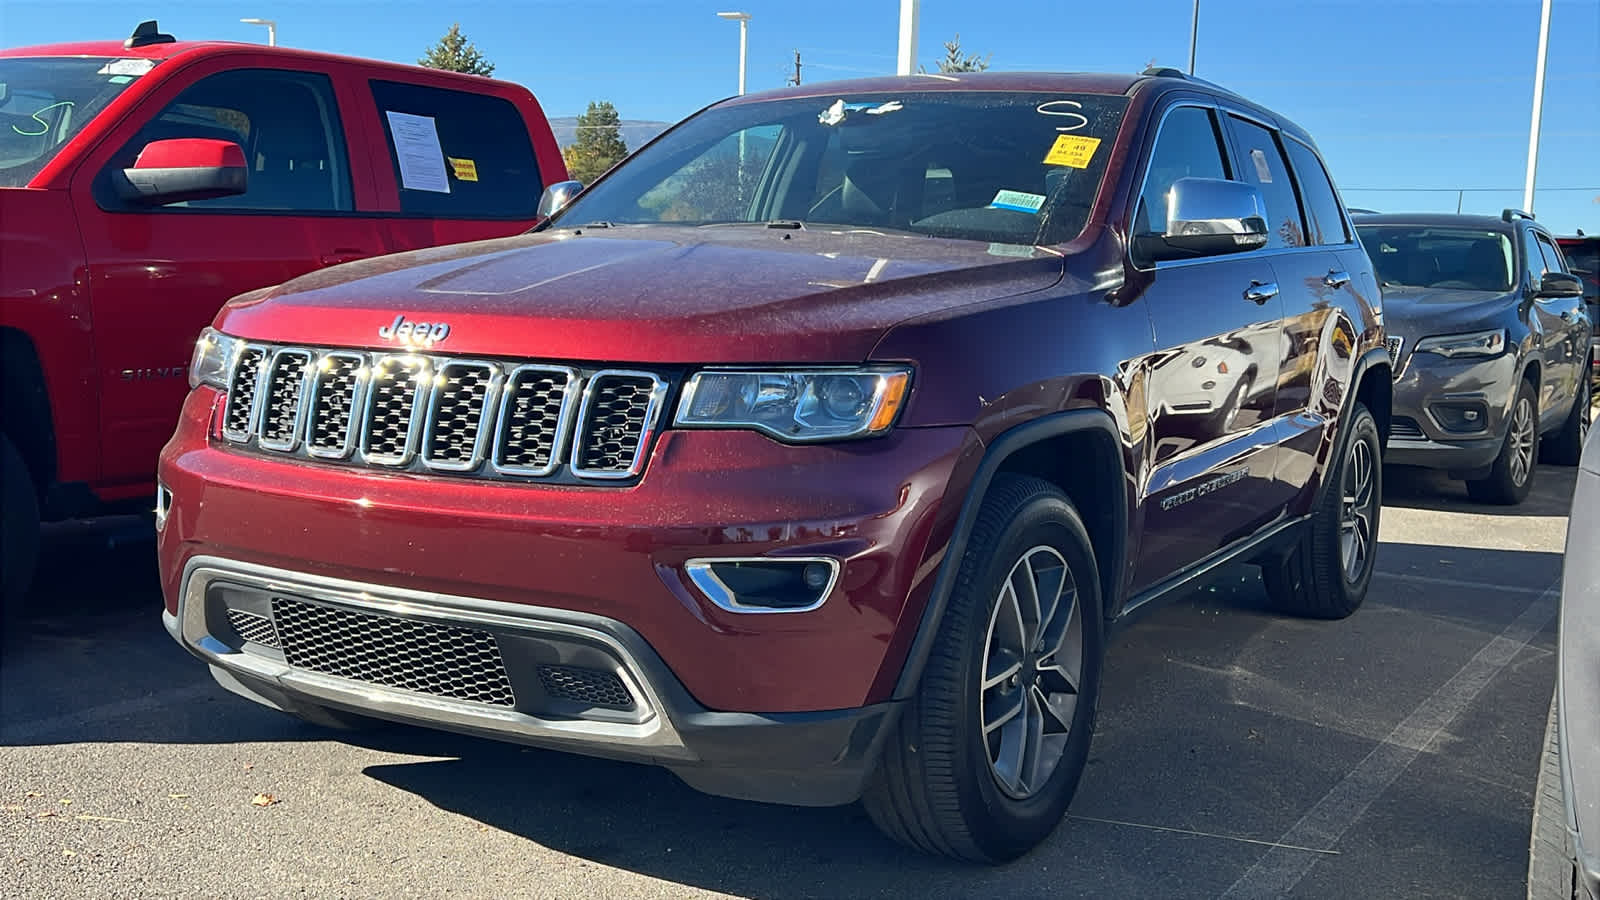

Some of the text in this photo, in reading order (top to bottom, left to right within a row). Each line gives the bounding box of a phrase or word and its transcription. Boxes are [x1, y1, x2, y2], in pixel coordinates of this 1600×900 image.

[1036, 100, 1088, 131] S
[379, 314, 450, 347] Jeep
[120, 367, 190, 381] SILVE
